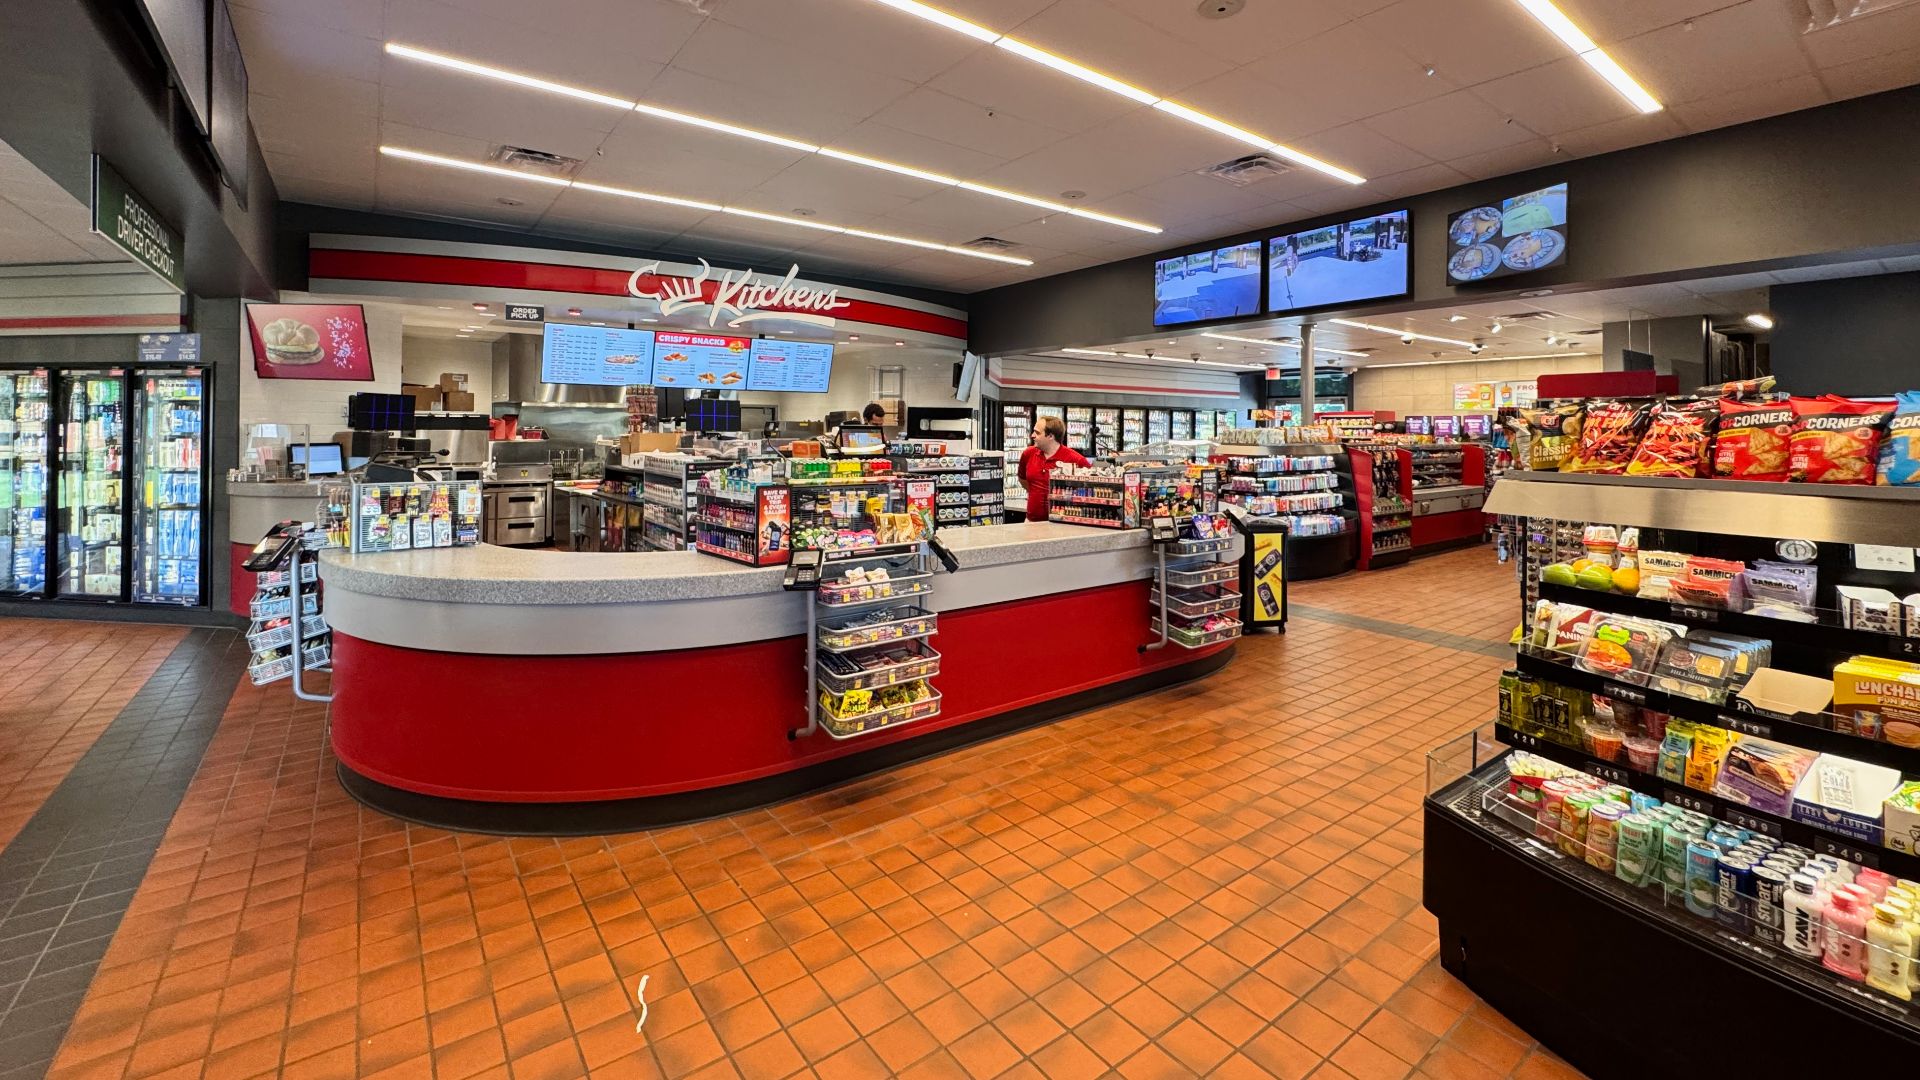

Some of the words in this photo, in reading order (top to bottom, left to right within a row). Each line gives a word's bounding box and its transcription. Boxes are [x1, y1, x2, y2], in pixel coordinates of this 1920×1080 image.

[124, 192, 171, 254] PROFESSIONAL
[117, 214, 144, 255] DRIVER
[144, 238, 175, 278] CHECKOUT
[708, 263, 850, 328] Kitchens
[658, 334, 690, 344] CRISPY
[691, 337, 726, 346] SNACKS
[1533, 443, 1571, 458] Classic
[1644, 557, 1684, 568] SAMMICH
[1692, 568, 1736, 580] SAMMICH
[1677, 585, 1719, 598] SAMMICH
[1751, 578, 1798, 592] SAMMICH
[1877, 696, 1898, 705] FUN
[1719, 869, 1731, 908] smart
[1756, 880, 1771, 923] smart
